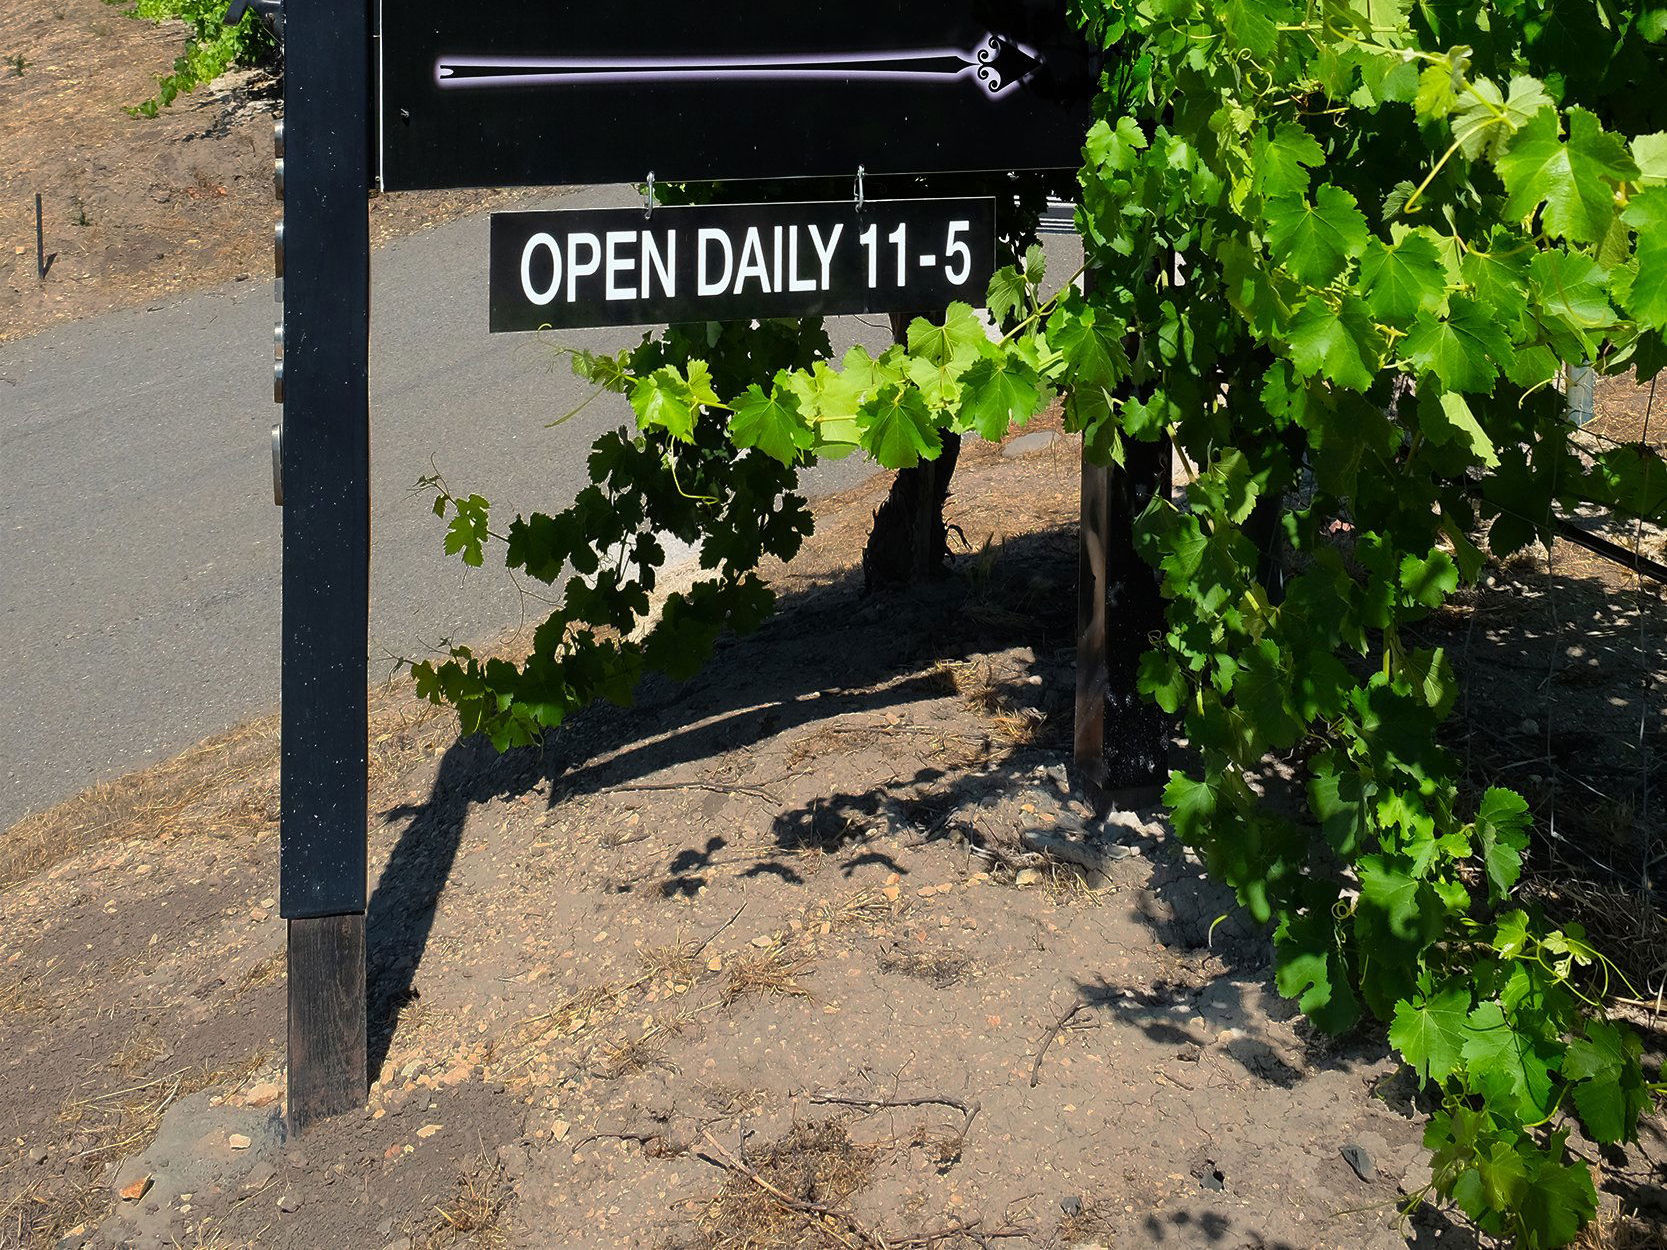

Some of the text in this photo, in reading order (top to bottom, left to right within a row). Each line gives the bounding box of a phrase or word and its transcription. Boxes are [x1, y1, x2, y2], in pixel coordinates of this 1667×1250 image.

[520, 220, 972, 305] OPEN DAILY 11-5
